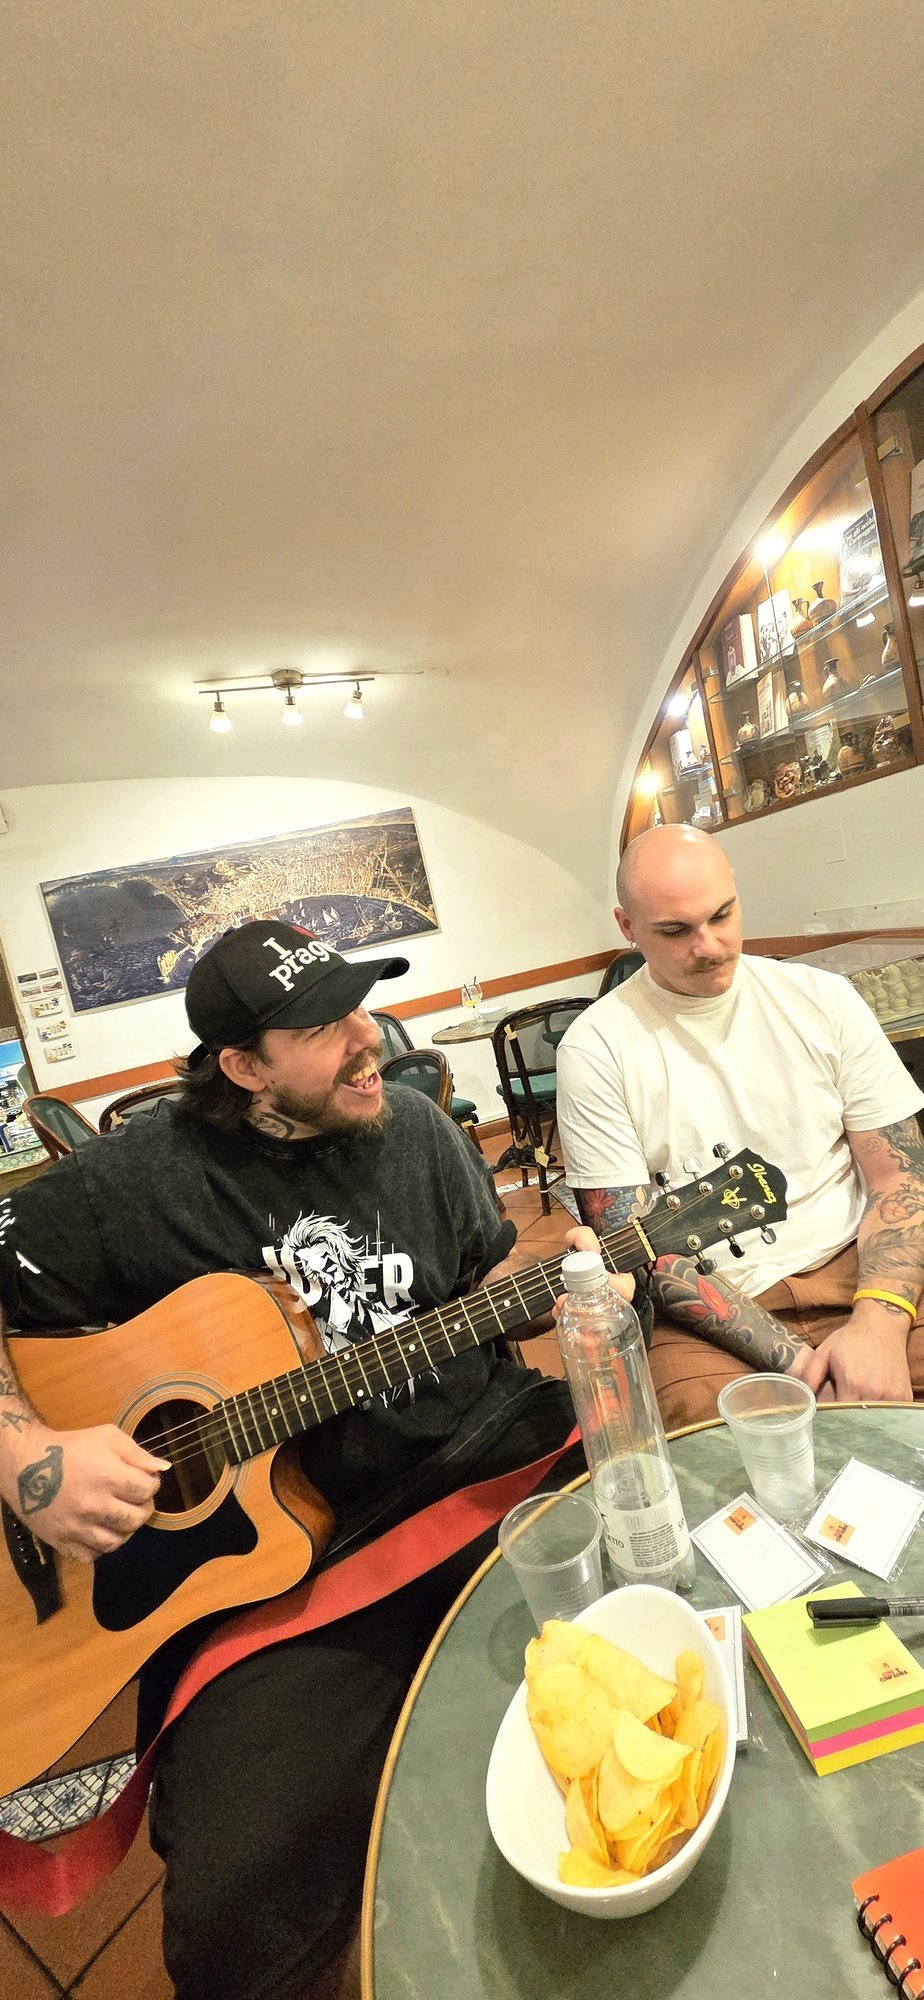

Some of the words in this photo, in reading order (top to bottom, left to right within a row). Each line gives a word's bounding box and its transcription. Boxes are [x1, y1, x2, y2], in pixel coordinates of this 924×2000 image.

[262, 936, 293, 960] I
[268, 940, 335, 992] prag
[746, 1163, 777, 1204] Ibanez
[261, 1245, 415, 1309] JOER
